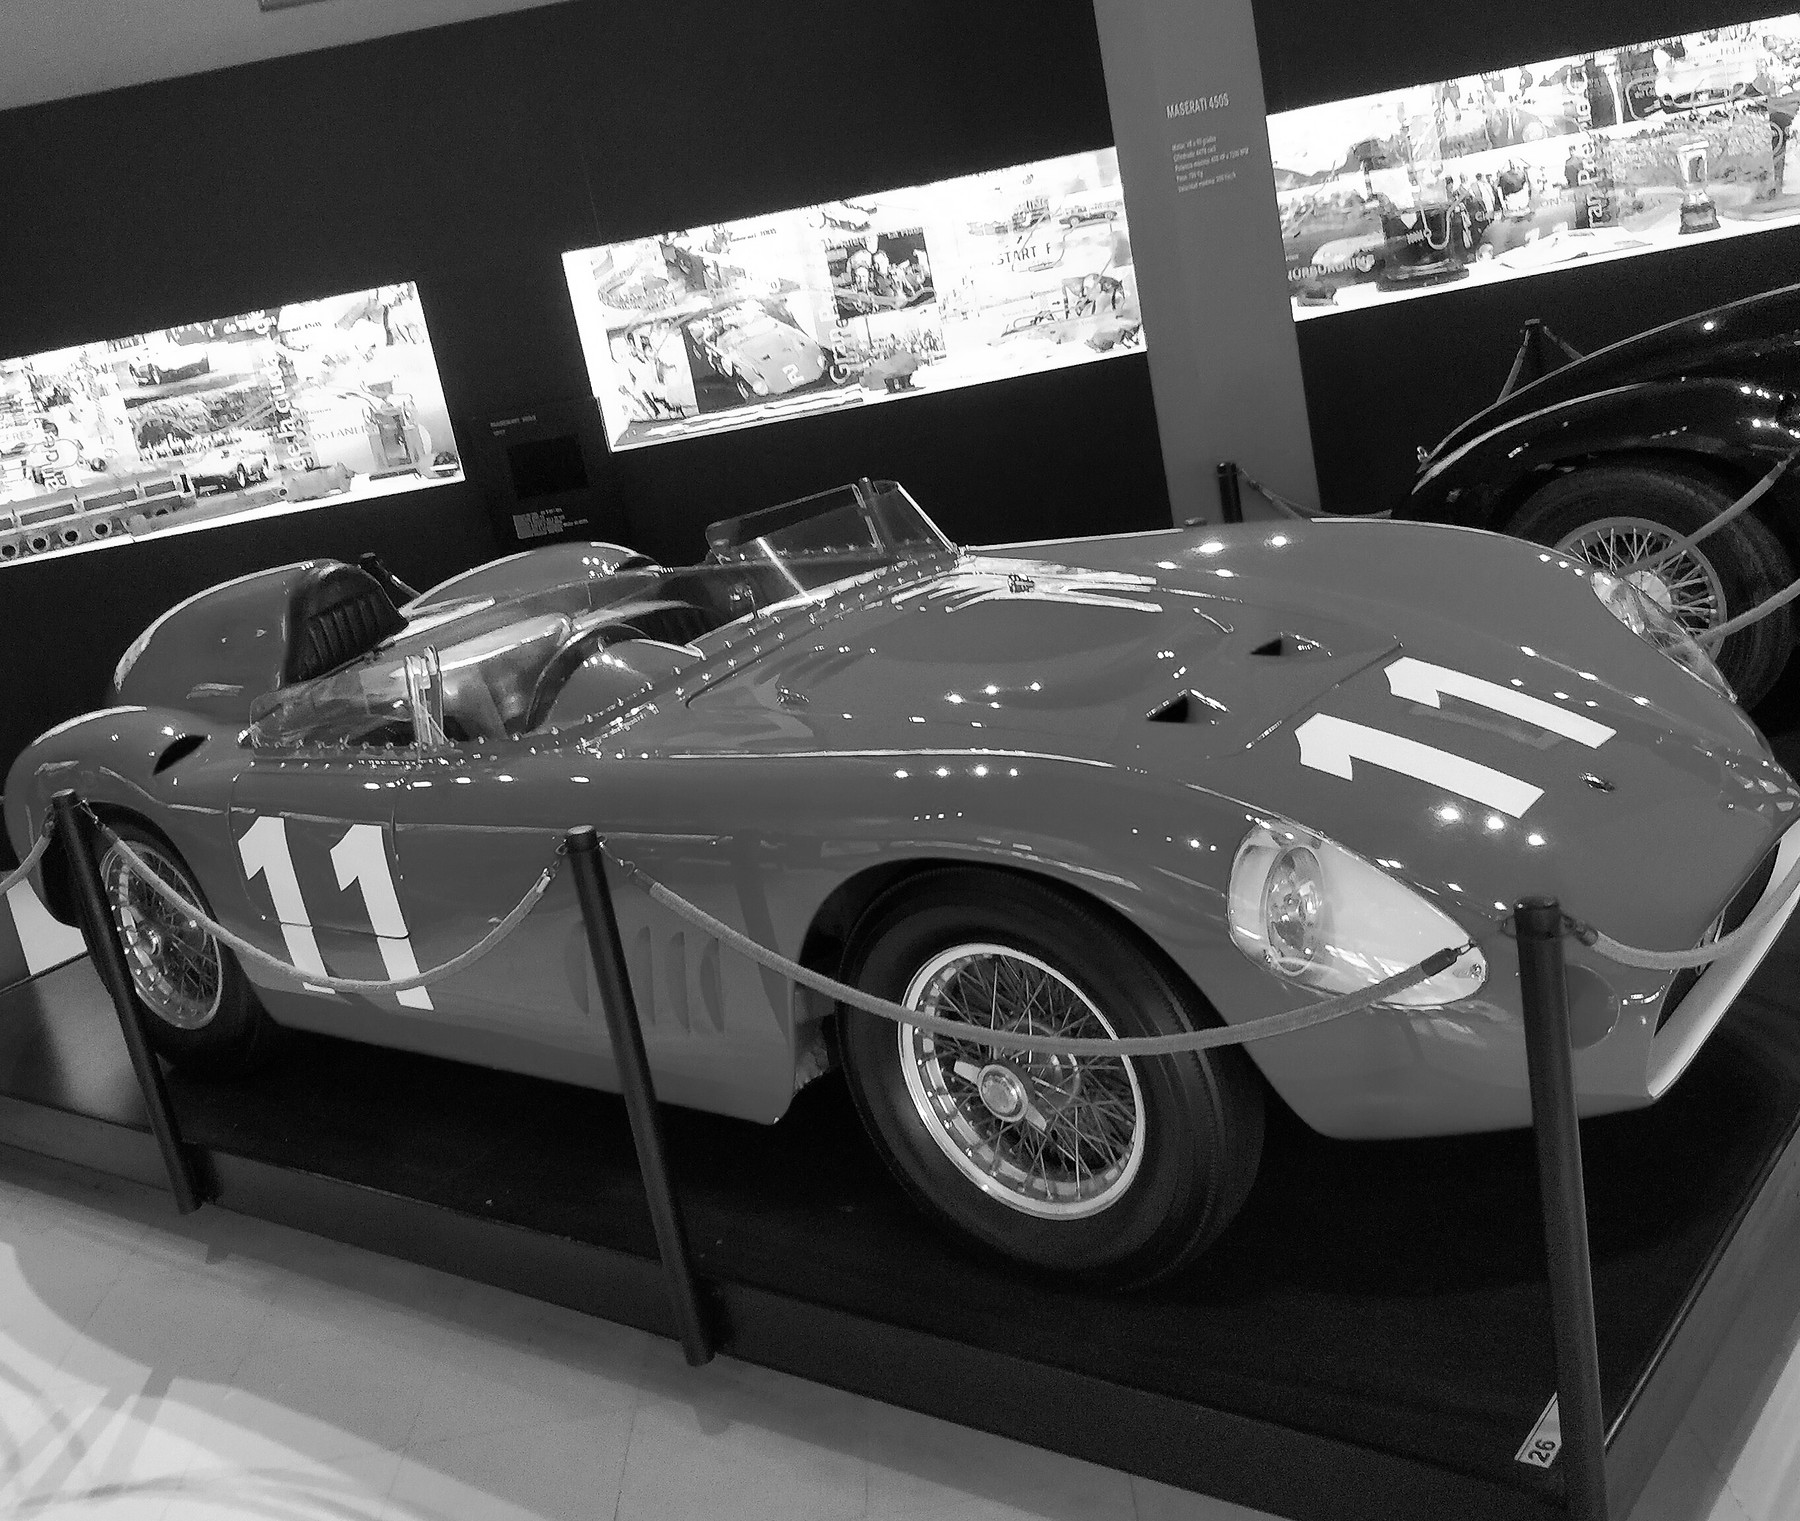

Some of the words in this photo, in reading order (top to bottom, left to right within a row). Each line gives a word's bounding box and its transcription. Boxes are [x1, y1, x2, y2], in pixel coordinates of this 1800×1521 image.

[1166, 98, 1207, 119] MASERATI
[1208, 92, 1229, 109] 450S
[998, 246, 1037, 267] START
[1294, 656, 1618, 819] 11
[238, 816, 435, 1011] 11
[1528, 1441, 1556, 1463] 26
